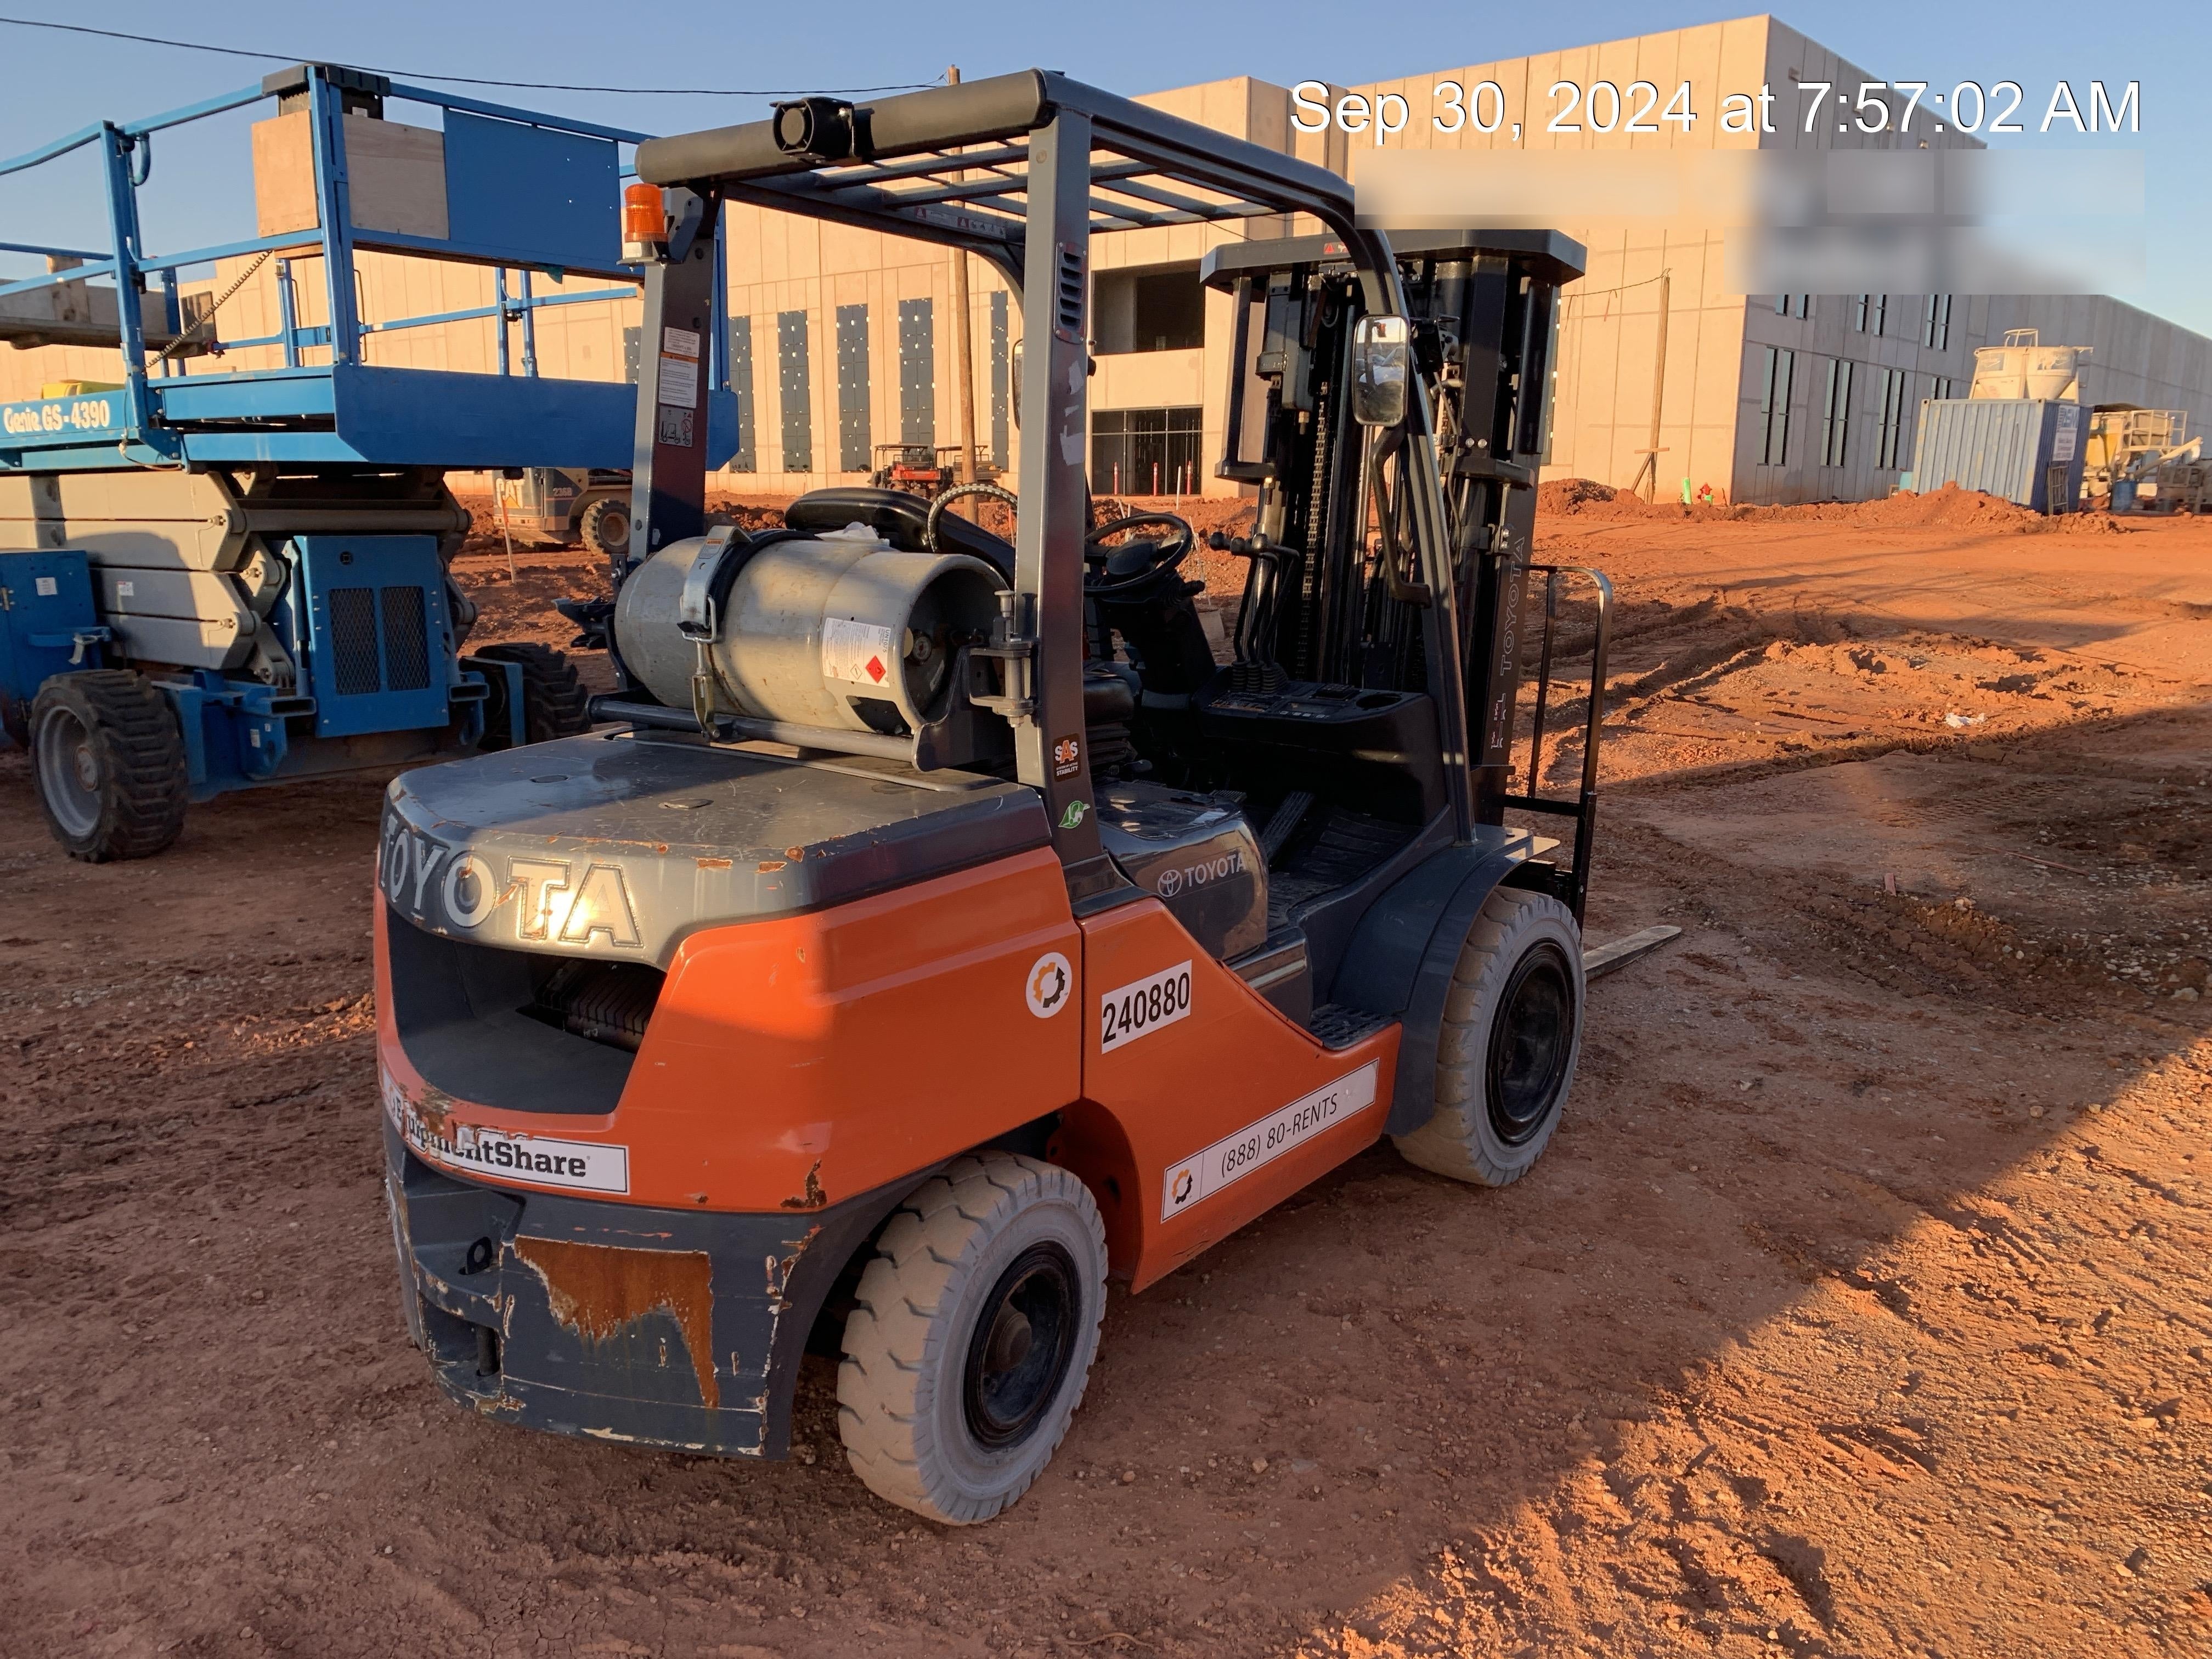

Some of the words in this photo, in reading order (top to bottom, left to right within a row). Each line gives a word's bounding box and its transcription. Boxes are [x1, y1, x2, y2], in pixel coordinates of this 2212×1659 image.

[4, 407, 42, 433] Genie
[42, 399, 110, 431] GS-4390
[495, 478, 525, 509] CAT
[1500, 536, 1525, 675] TOYOTA
[1055, 740, 1078, 764] SAS
[382, 812, 644, 949] TOYOTA
[1184, 852, 1246, 887] TOYOTA
[1103, 967, 1190, 1045] 240880
[1222, 1134, 1261, 1178] (888)
[1267, 1093, 1338, 1149] 80-RENTS
